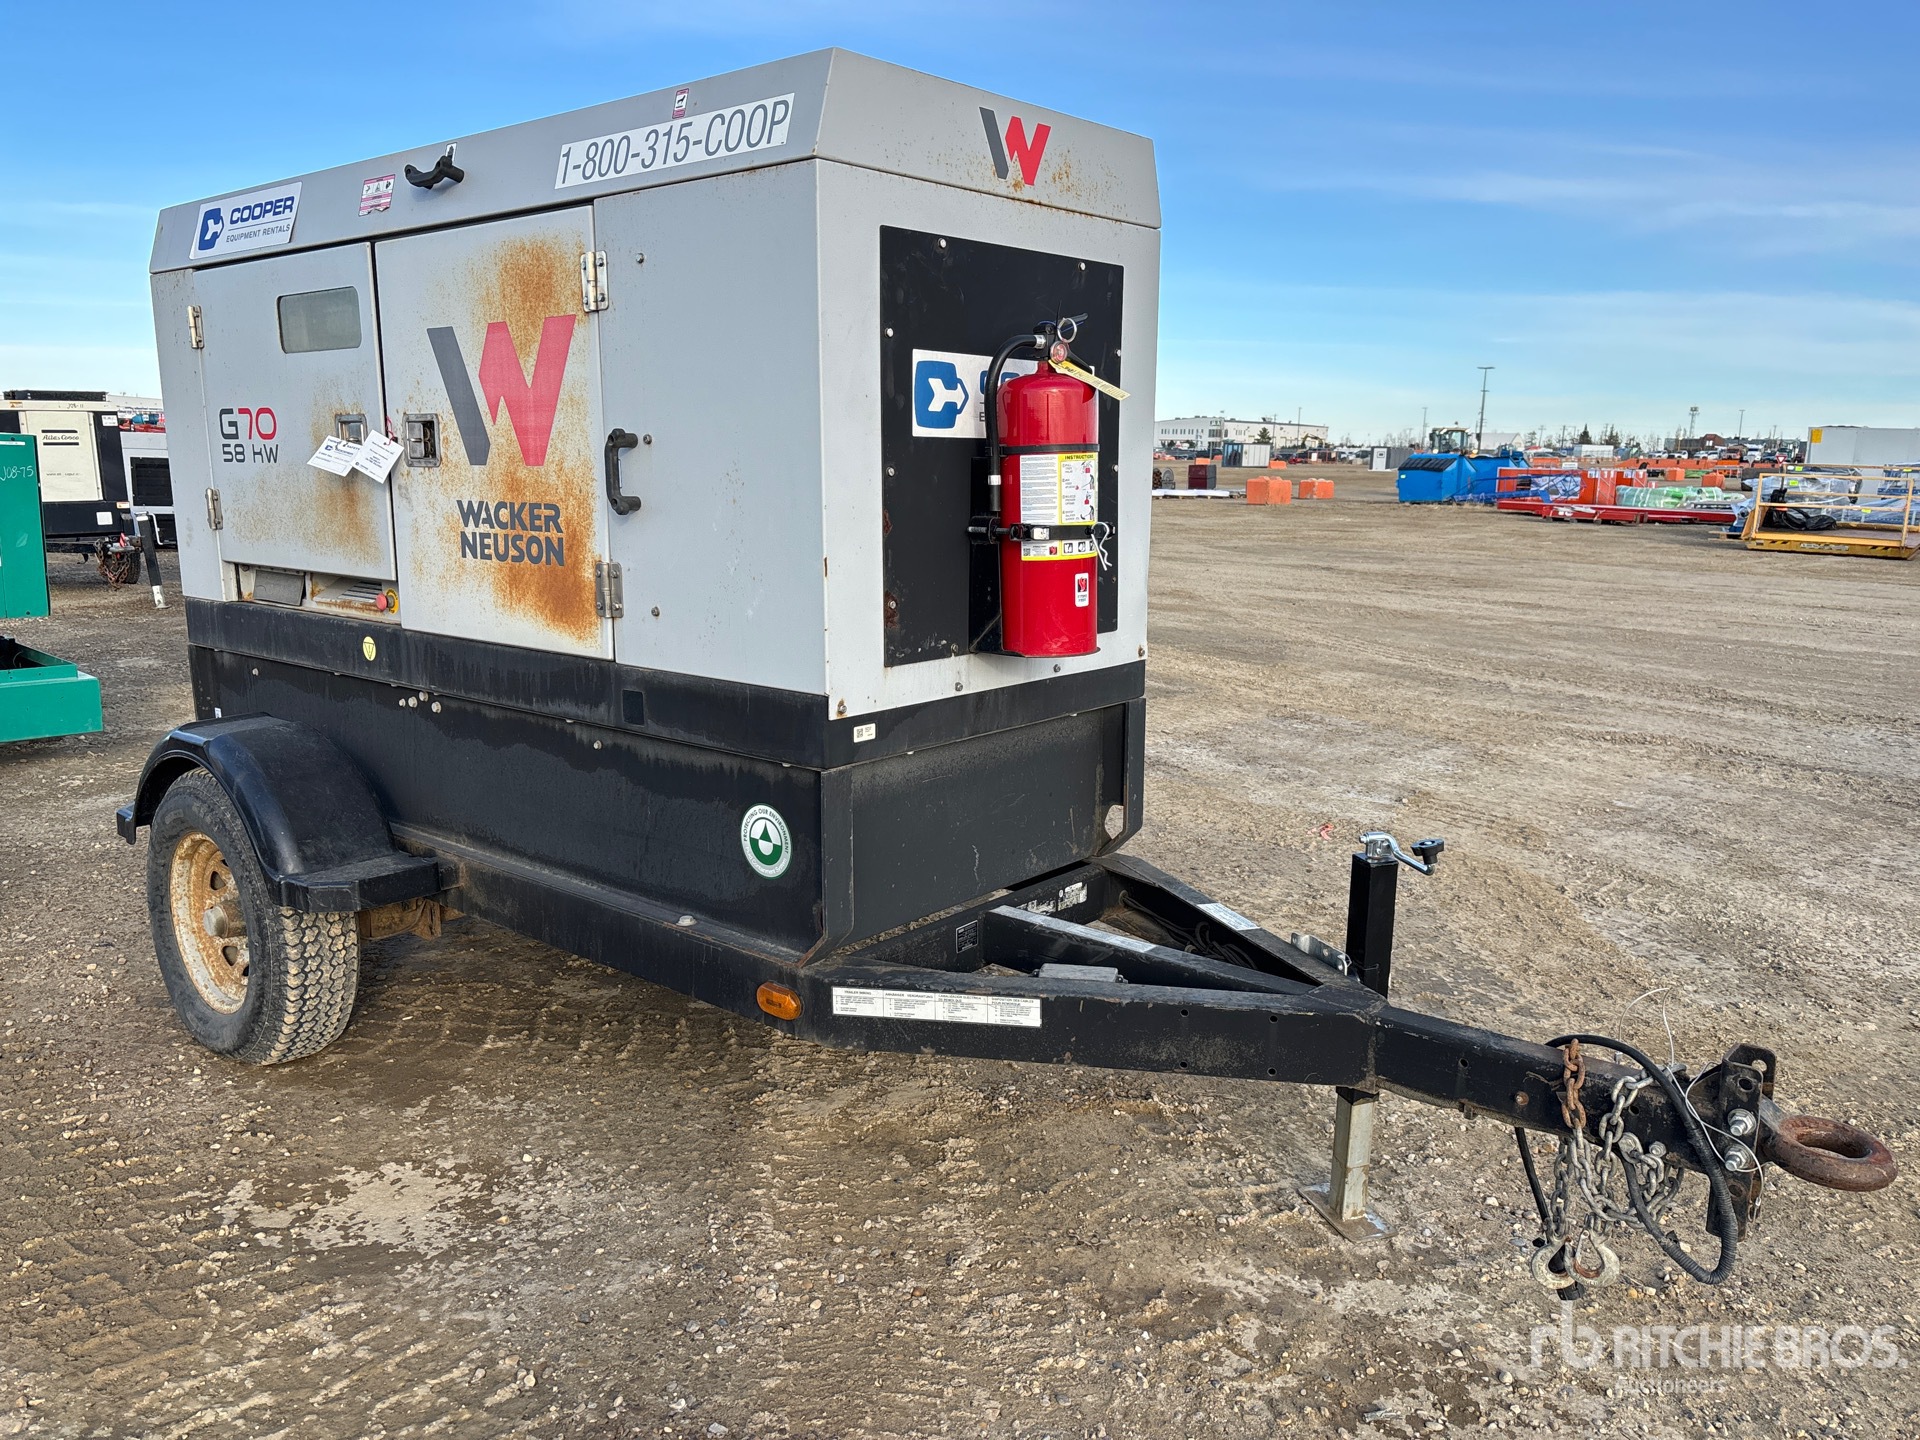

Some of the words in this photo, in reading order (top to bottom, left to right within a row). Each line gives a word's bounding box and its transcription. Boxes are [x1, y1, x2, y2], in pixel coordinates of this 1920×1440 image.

[561, 99, 790, 185] 1-800-315-COOP
[229, 196, 295, 225] COOPER
[226, 229, 261, 243] EQUIPMENT
[262, 223, 291, 236] RENTALS
[219, 407, 277, 440] G70
[222, 443, 246, 463] 58
[0, 465, 34, 481] J08-75
[457, 499, 564, 533] WACKER
[460, 531, 565, 567] NEUSON
[743, 809, 758, 842] PROTECTING
[768, 811, 789, 854] ENVIRONMENT
